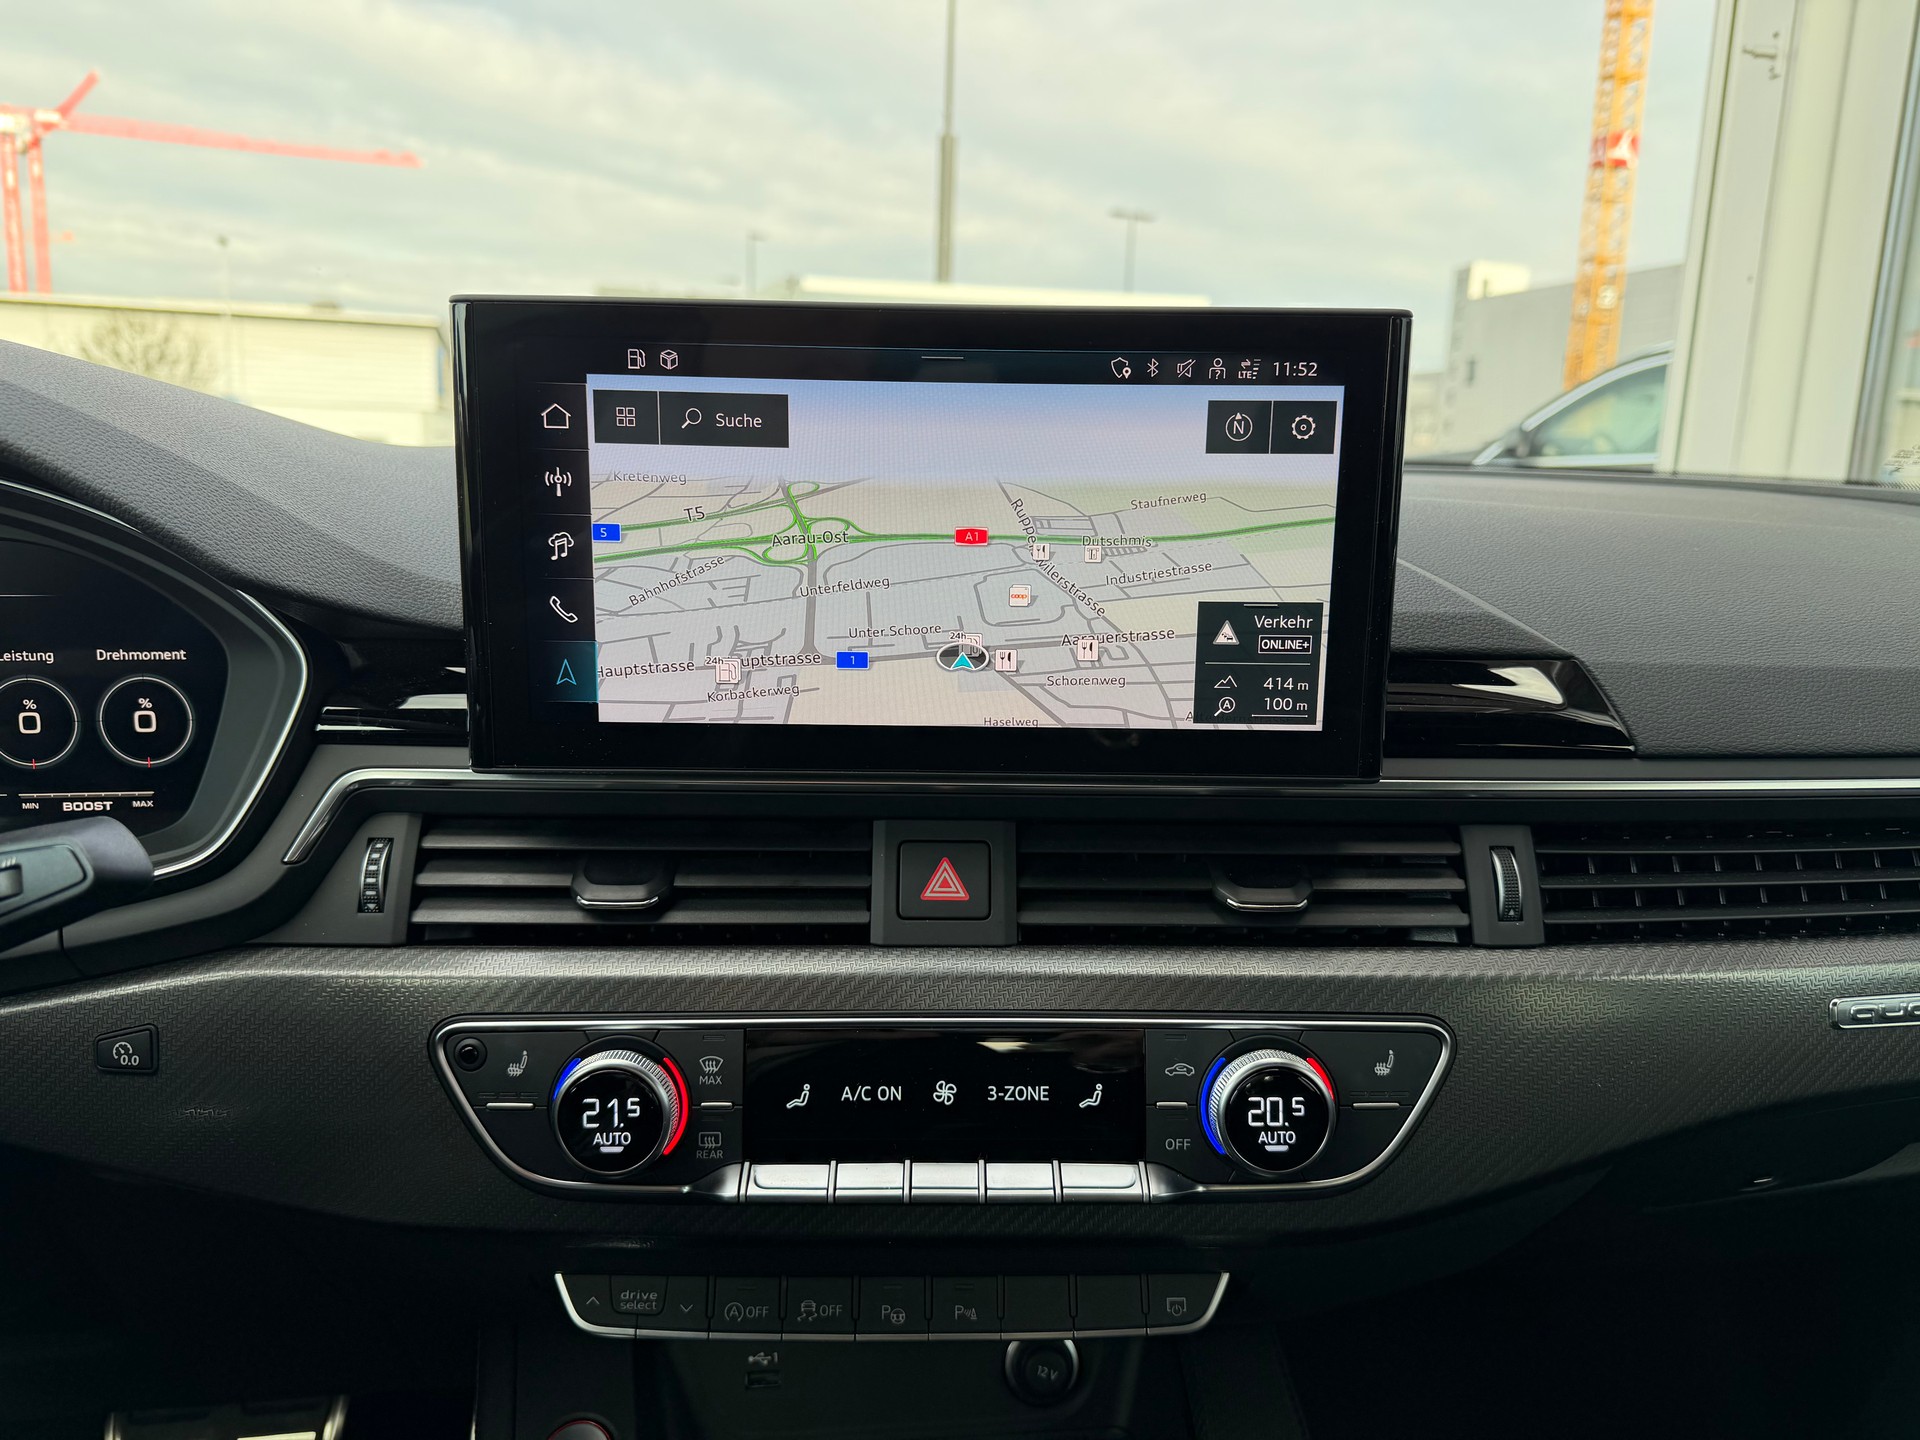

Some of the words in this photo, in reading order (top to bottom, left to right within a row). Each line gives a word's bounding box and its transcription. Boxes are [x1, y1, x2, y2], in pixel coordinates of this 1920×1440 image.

[1273, 362, 1318, 377] 11:52
[715, 413, 763, 429] Suche
[1233, 420, 1245, 435] N
[613, 471, 687, 485] Kretenweg
[1130, 492, 1207, 510] Staufnerweg
[684, 505, 706, 522] T5
[600, 527, 608, 538] 5
[772, 530, 849, 547] Aarau-Ost
[964, 531, 980, 541] A1
[1082, 535, 1152, 548] Dutschmis
[1011, 498, 1106, 617] Ruppewilerstrasse
[1105, 561, 1212, 586] Industriestrasse
[628, 555, 725, 606] Bahnhofstrasse
[799, 577, 890, 598] Unterfeldweg
[1254, 614, 1313, 629] Verkehr
[849, 626, 886, 639] Unter
[889, 623, 942, 636] Schoore
[950, 632, 967, 640] 24h
[1261, 639, 1310, 650] ONLINE+
[0, 650, 54, 664] eistung
[96, 649, 187, 661] Drehmoment
[706, 656, 724, 665] 24h
[741, 652, 821, 669] uptstrasse
[850, 655, 856, 665] 1
[1046, 675, 1126, 688] Schorenweg
[1263, 677, 1294, 691] 414
[1297, 682, 1309, 691] m
[707, 685, 800, 703] Korbackerweg
[23, 699, 37, 710] %
[138, 698, 153, 709] %
[1264, 698, 1293, 711] 100
[1296, 702, 1308, 711] m
[983, 717, 1039, 727] Haselweg
[22, 802, 40, 810] MIN
[62, 801, 113, 812] BOOST
[132, 800, 154, 808] MAX
[120, 1054, 140, 1066] 0.0
[699, 1075, 723, 1085] MAX
[841, 1085, 872, 1101] A/C
[877, 1085, 902, 1101] ON
[987, 1085, 1050, 1101] 3-ZONE
[593, 1132, 632, 1145] AUTO
[1165, 1138, 1191, 1150] OFF
[1258, 1131, 1297, 1144] AUTO
[696, 1150, 724, 1159] REAR
[620, 1289, 658, 1301] drive
[620, 1300, 657, 1311] select
[746, 1305, 769, 1318] OFF
[820, 1304, 843, 1317] OFF
[881, 1305, 891, 1319] P
[955, 1305, 963, 1320] P
